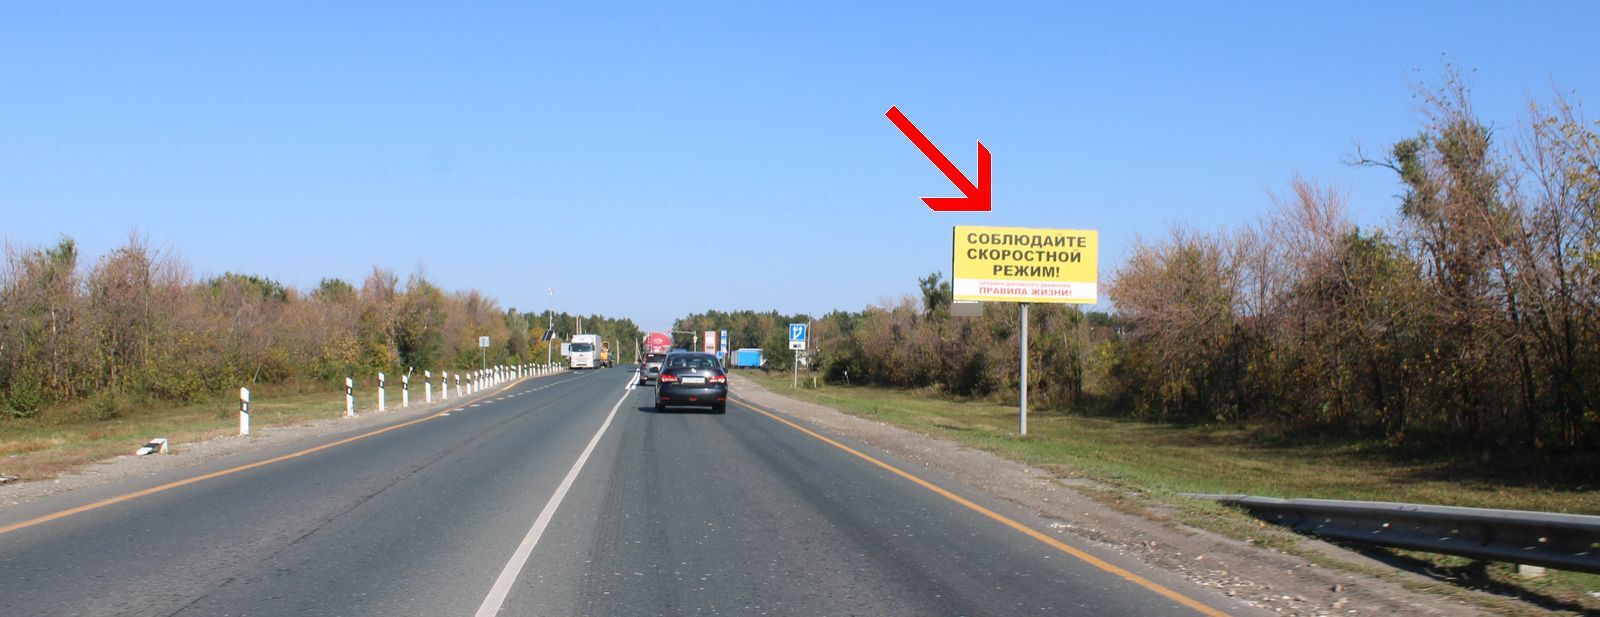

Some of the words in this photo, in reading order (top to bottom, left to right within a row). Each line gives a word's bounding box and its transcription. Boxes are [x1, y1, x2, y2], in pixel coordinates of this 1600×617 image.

[967, 232, 1087, 248] СОБЛЮДАЙТЕ
[967, 248, 1081, 263] СКОРОСТНОЙ
[993, 265, 1060, 277] РЕЖИМ!
[979, 287, 1028, 296] ПРАВИЛА
[1031, 288, 1072, 297] ЖИЗНИ!
